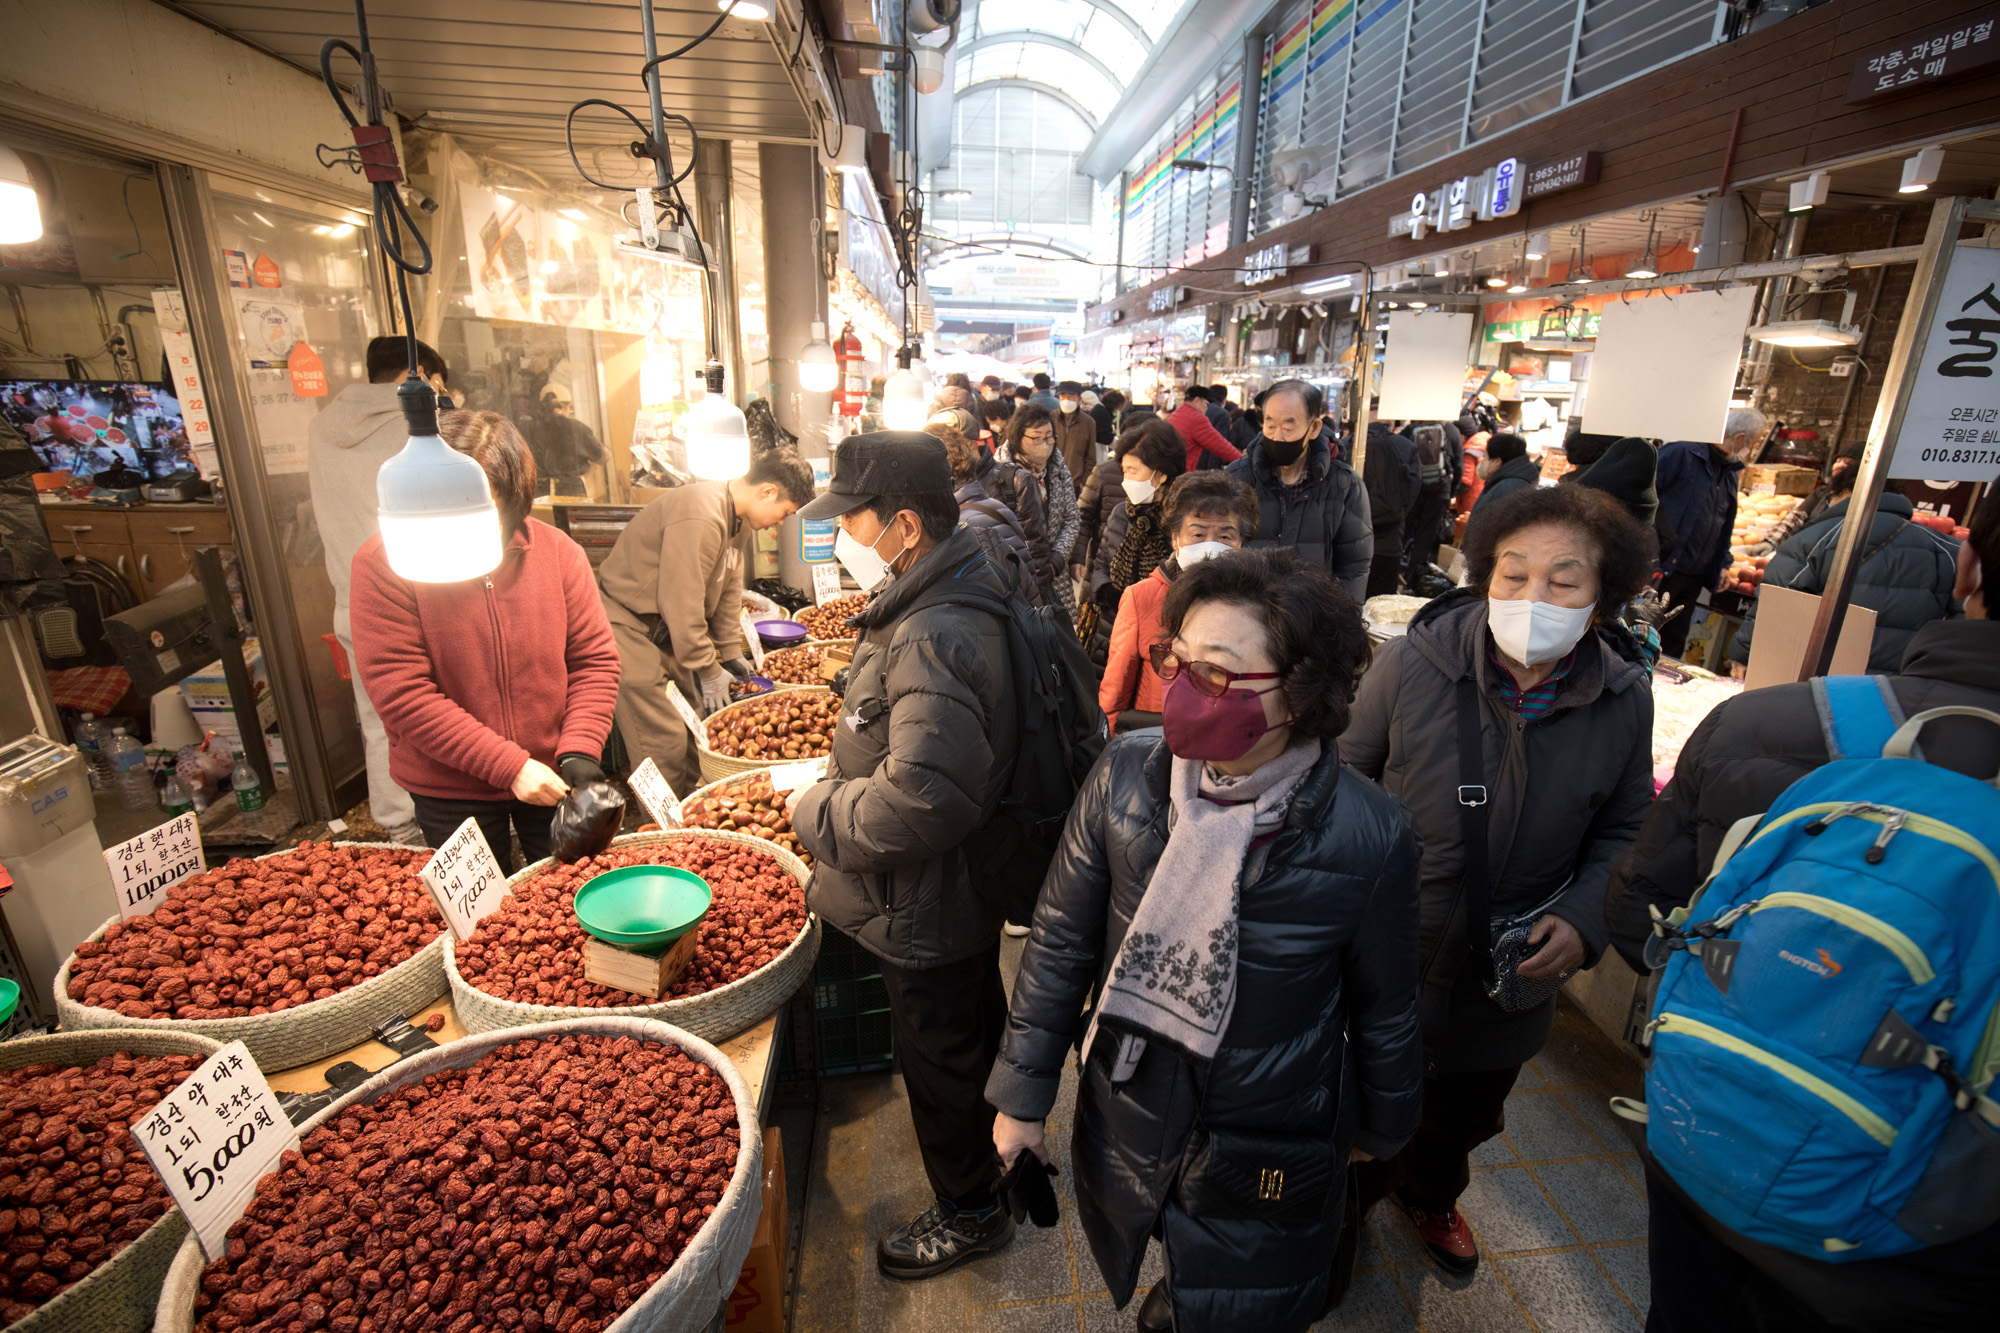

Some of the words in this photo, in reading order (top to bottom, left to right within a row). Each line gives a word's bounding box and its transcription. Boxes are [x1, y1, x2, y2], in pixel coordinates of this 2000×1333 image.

[1867, 19, 1994, 73] 각종.과일일절
[1493, 161, 1513, 214] 유통
[184, 377, 197, 388] 15
[189, 399, 203, 410] 22
[1948, 406, 1998, 425] 오픈시간
[194, 421, 209, 432] 29
[1942, 427, 1979, 444] 주일은
[31, 786, 68, 815] CAS
[117, 837, 146, 861] 경산
[146, 1102, 185, 1141] 경산
[188, 1082, 209, 1107] 약
[212, 1054, 243, 1083] 대추
[215, 1084, 253, 1120] 한국산
